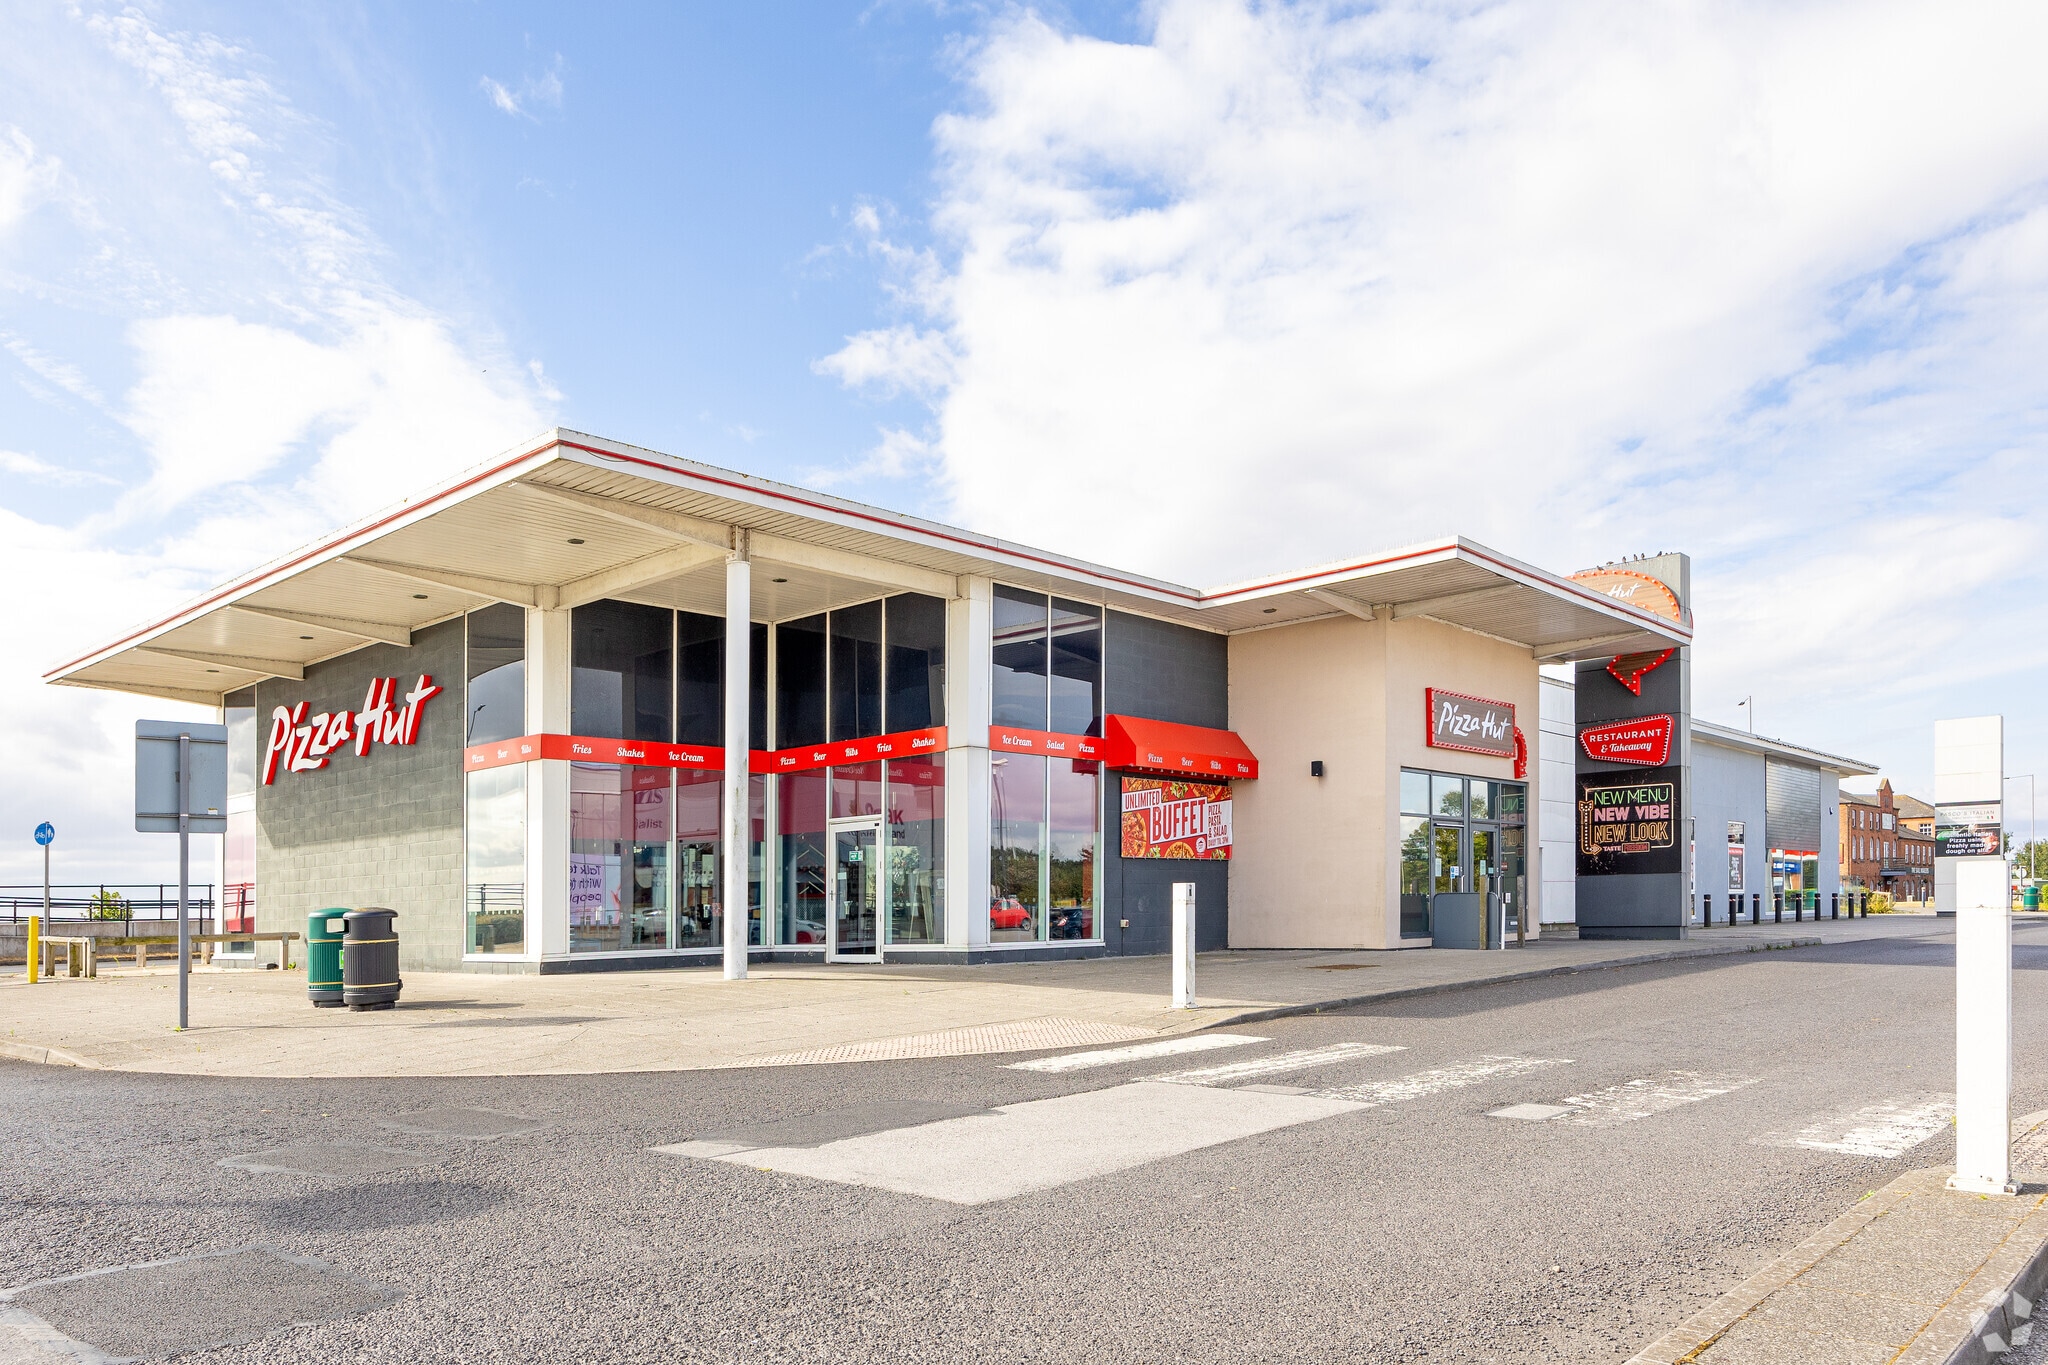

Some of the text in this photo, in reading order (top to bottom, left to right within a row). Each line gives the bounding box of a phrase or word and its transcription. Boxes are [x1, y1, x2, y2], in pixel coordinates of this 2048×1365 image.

[1607, 583, 1642, 597] Hut
[262, 674, 443, 786] Pizza Hut
[1437, 701, 1511, 741] Pizza Hut
[1001, 734, 1095, 753] Ice Cream Salad Pizza
[1589, 728, 1662, 743] RESTAURANT
[572, 743, 705, 763] Fries Shakes Ice Cream
[780, 737, 936, 766] Pizza Beer Ribs Fries Shakes
[1601, 742, 1652, 753] & Takeaway
[1147, 753, 1163, 764] Pizza
[1181, 756, 1194, 767] Beer
[1237, 763, 1249, 773] Fries
[1125, 790, 1160, 810] UNLIMITED
[1594, 787, 1669, 805] NEW MENU
[1152, 799, 1206, 842] BUFFET
[1208, 815, 1221, 827] PASTA
[1594, 804, 1670, 822] NEW VIBE
[1213, 824, 1228, 837] SALAD
[1594, 821, 1668, 843] NEW LOOK
